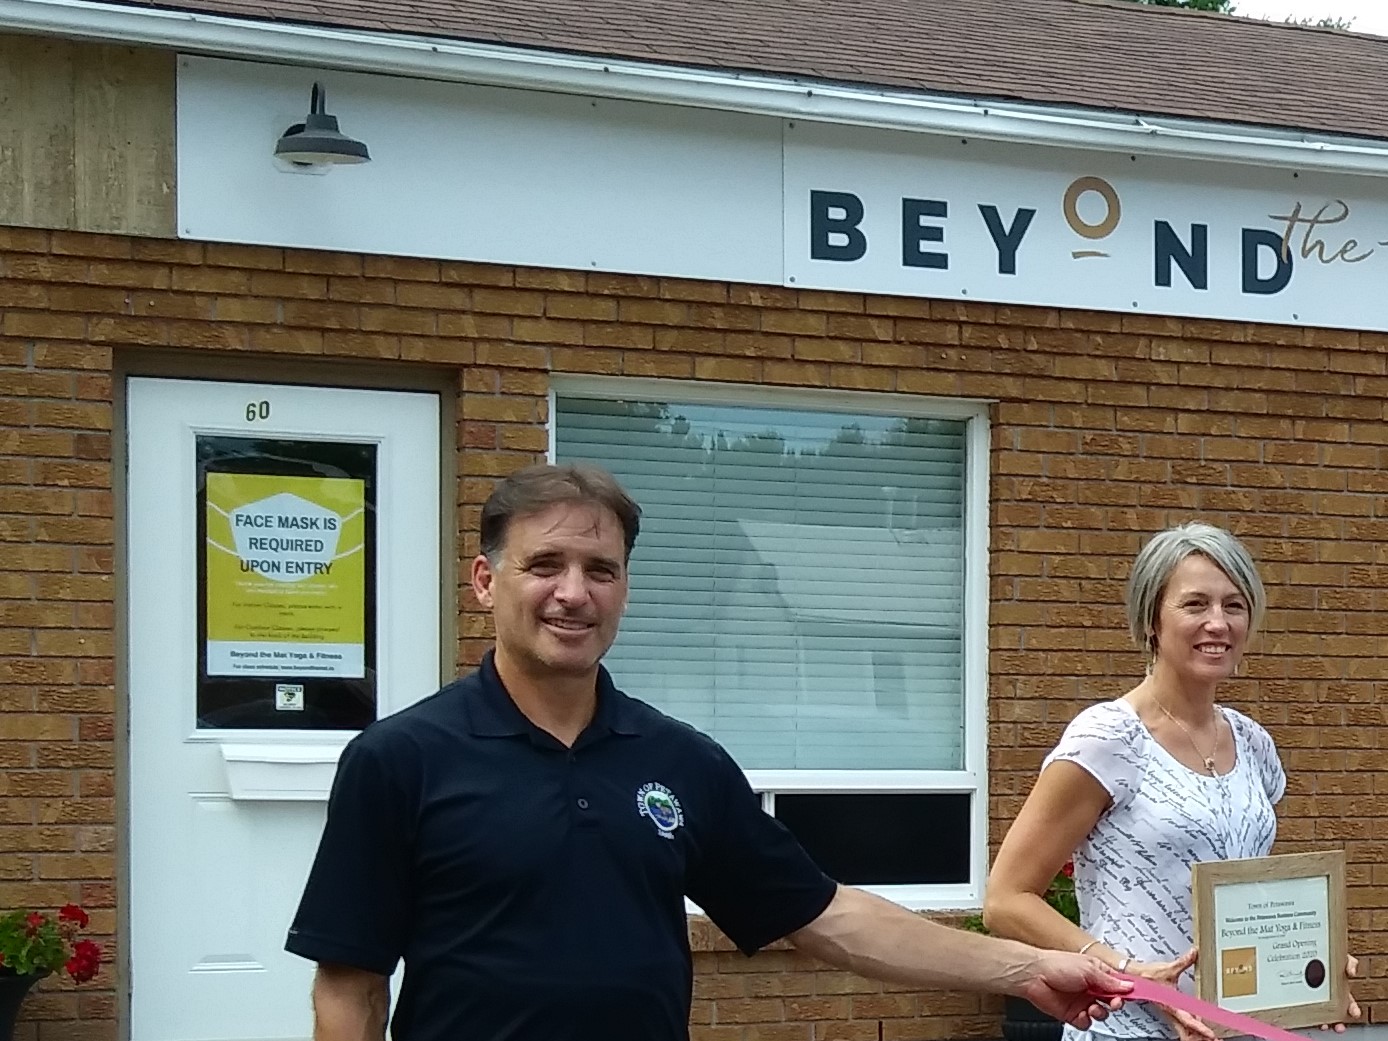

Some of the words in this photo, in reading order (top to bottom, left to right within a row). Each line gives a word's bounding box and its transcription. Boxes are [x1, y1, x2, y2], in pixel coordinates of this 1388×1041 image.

[810, 176, 1294, 295] BEYOND
[1269, 200, 1376, 269] the
[245, 400, 271, 422] 60
[235, 514, 274, 528] FACE
[278, 515, 320, 530] MASK
[323, 518, 337, 530] IS
[249, 537, 324, 553] REQUIRED
[240, 560, 280, 573] UPON
[285, 561, 333, 575] ENTRY
[230, 651, 258, 660] Beyond
[316, 652, 343, 660] Fitness
[636, 788, 649, 817] TOWN
[643, 783, 654, 792] OF
[1221, 926, 1246, 939] Beyond
[1248, 926, 1258, 935] the
[1260, 924, 1274, 934] Mat
[1275, 922, 1291, 934] Yoga
[1292, 922, 1298, 930] &
[1300, 921, 1321, 930] Fitness
[1273, 940, 1291, 949] Grand
[1292, 939, 1317, 949] Opening
